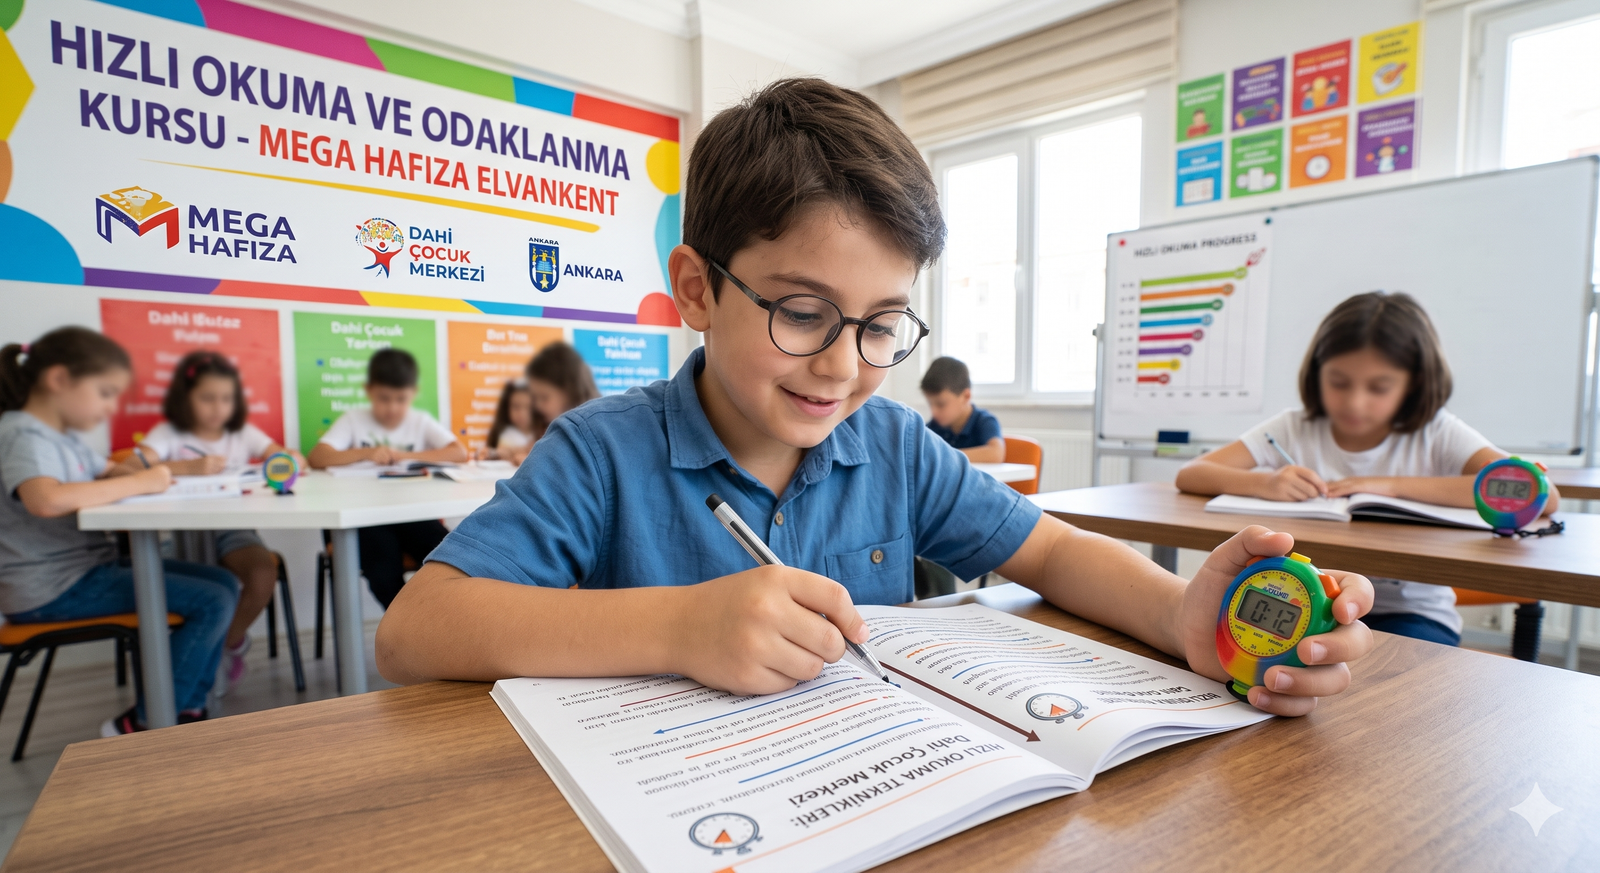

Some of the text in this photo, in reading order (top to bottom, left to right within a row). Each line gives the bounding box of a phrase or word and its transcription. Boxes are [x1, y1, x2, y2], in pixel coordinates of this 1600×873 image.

[50, 19, 630, 181] HIZLI OKUMA VE ODAKLANMA
[80, 88, 226, 150] KURSU
[259, 124, 356, 171] MEGA
[364, 144, 470, 191] HAFIZA
[477, 165, 619, 216] ELVANKENT
[188, 204, 296, 241] MEGA
[409, 226, 453, 245] DAHİ
[188, 233, 297, 264] HAFIZA
[409, 244, 471, 264] ÇOCUK
[528, 237, 560, 246] ANKARA
[409, 262, 485, 283] MERKEZİ
[563, 263, 624, 283] ANKARA
[1250, 599, 1297, 635] 0:12
[927, 734, 971, 749] Dahi
[962, 742, 1005, 756] HIZLI
[868, 745, 927, 775] Çocuk
[900, 752, 964, 780] OKUMA
[788, 770, 870, 808] Merkezi
[790, 778, 904, 828] TEKNİKLERİ:
